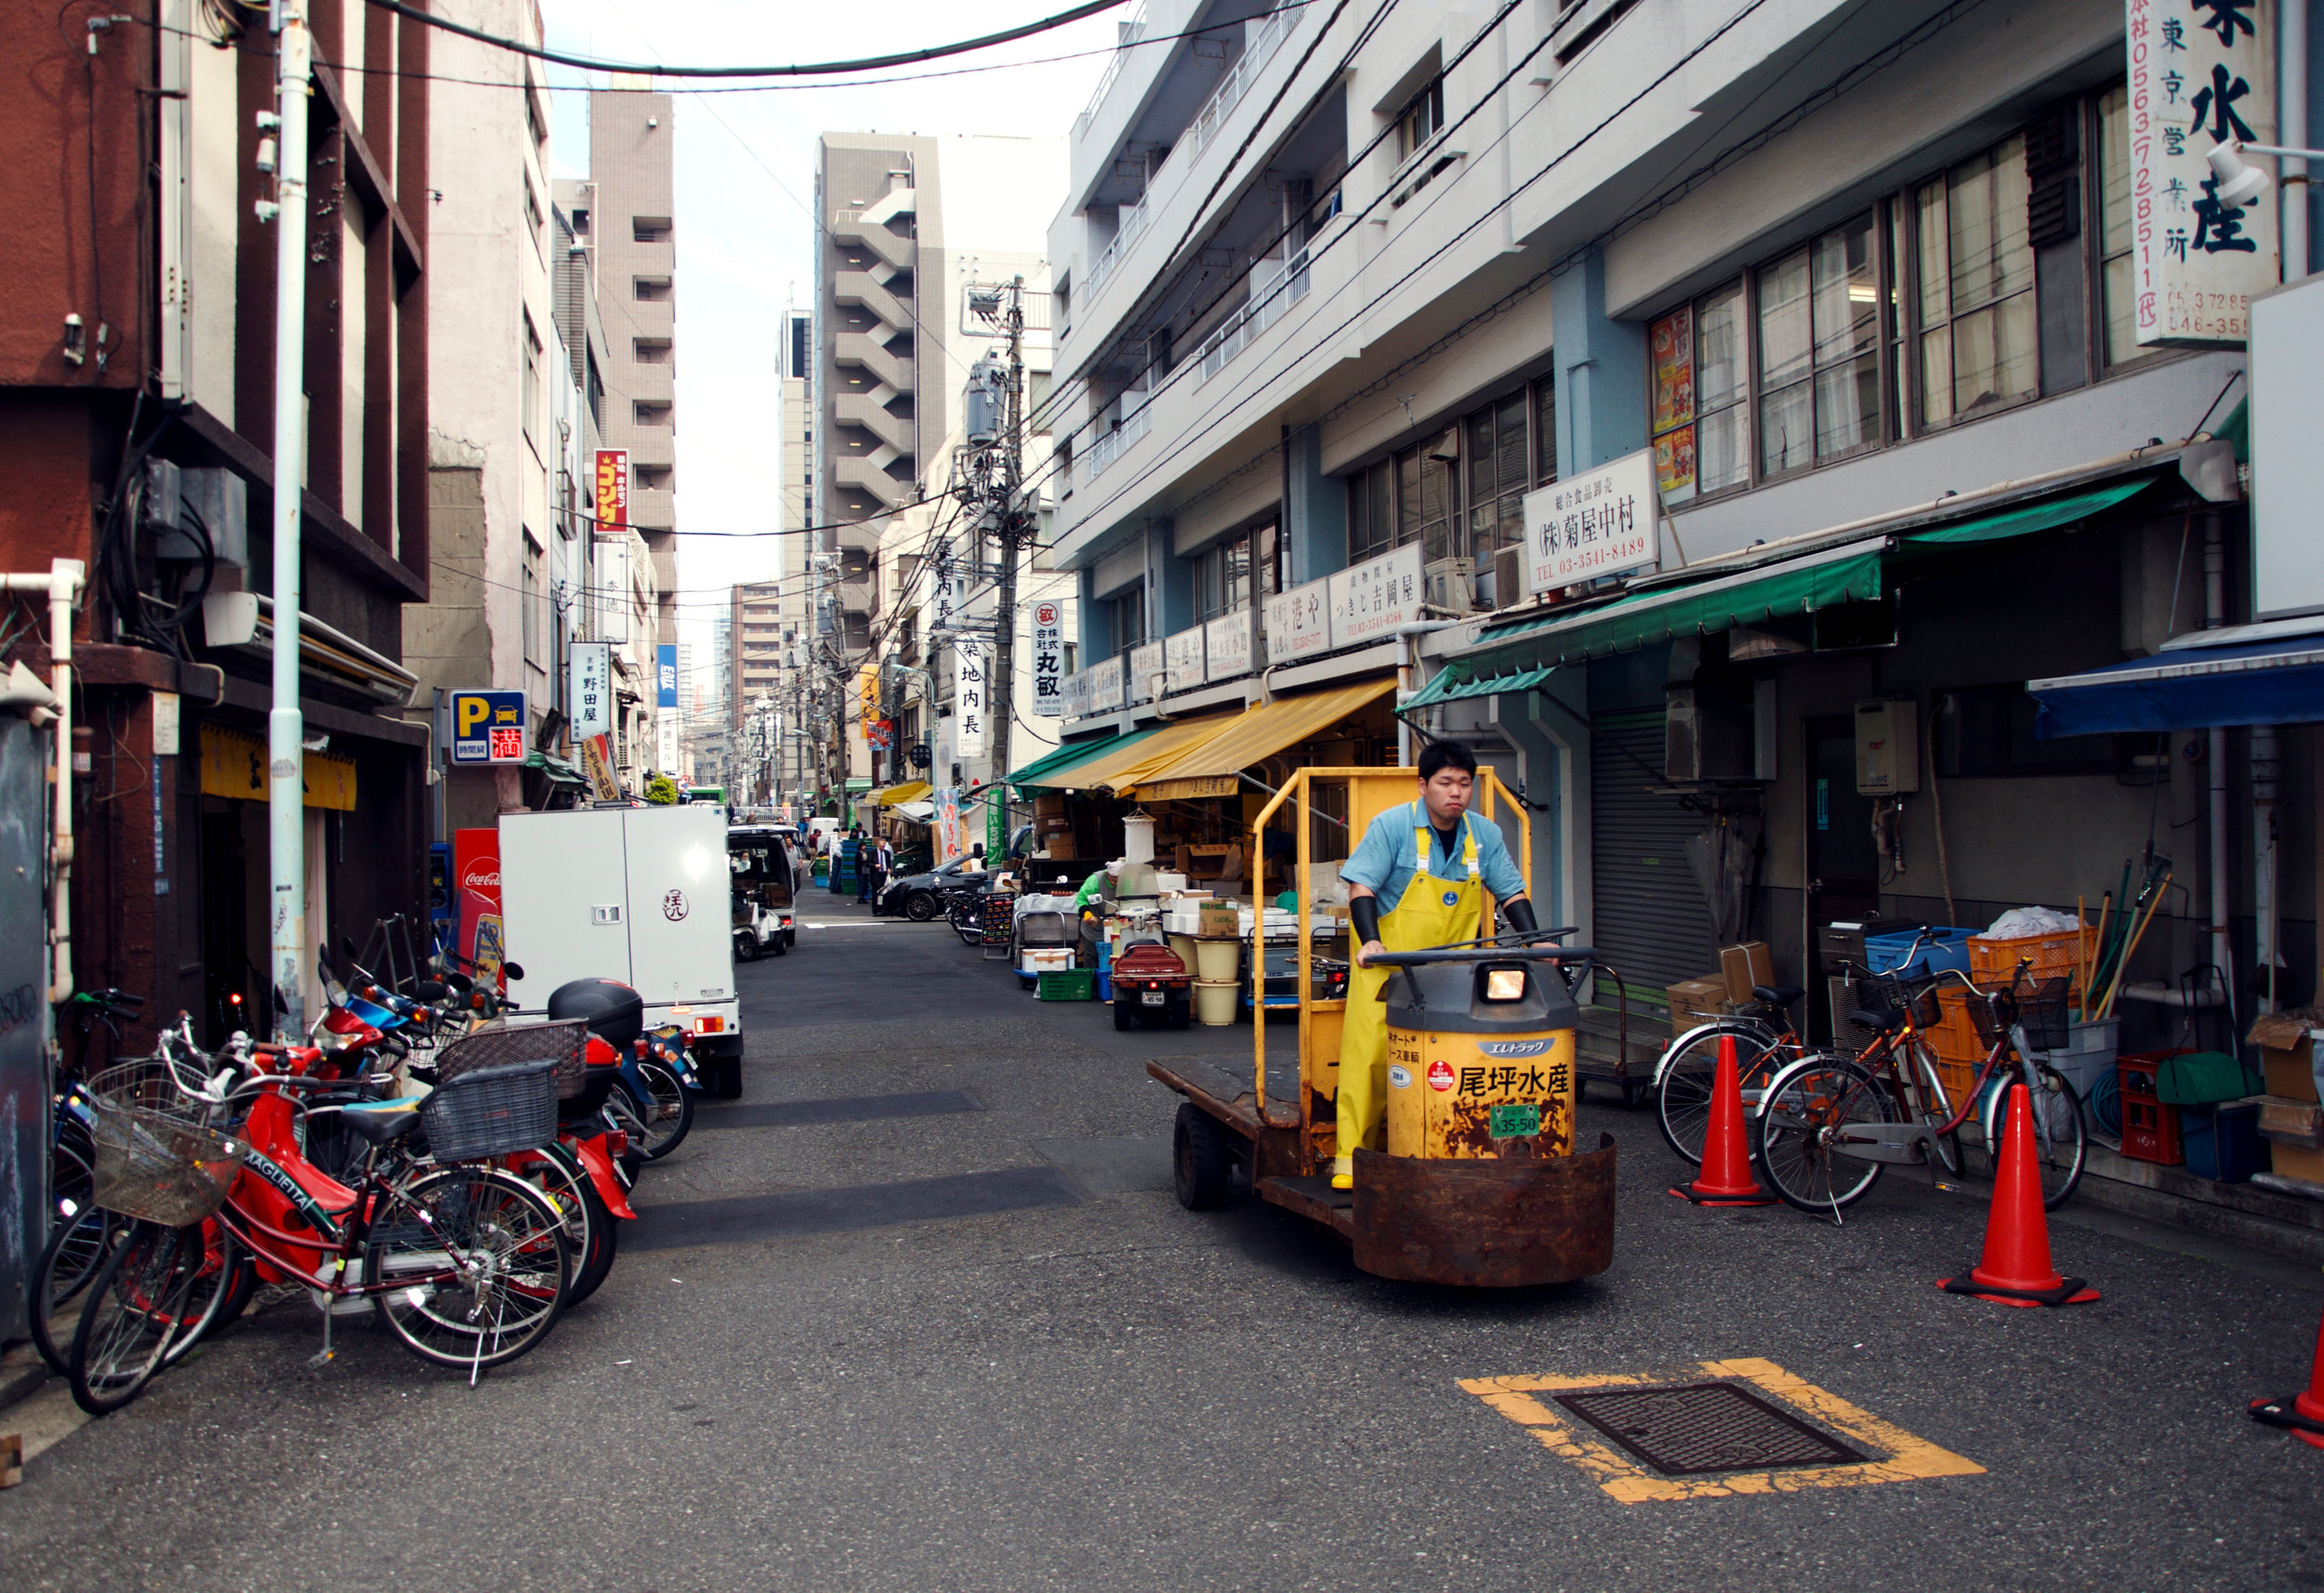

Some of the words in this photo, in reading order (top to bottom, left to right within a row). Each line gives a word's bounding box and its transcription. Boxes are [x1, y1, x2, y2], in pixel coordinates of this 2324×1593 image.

[2160, 17, 2189, 264] 東京営業所
[598, 464, 617, 528] ゴング
[1536, 564, 1554, 582] TEL
[1559, 536, 1644, 575] 03-3541-8489
[1038, 608, 1054, 623] 敏
[961, 638, 981, 734] 築地内長
[1036, 652, 1061, 697] 丸敏
[457, 697, 490, 737] P
[584, 678, 598, 721] 野田屋
[458, 744, 485, 756] 時間貸
[491, 729, 522, 758] 満
[1489, 1042, 1545, 1054] エレトラック
[1457, 1062, 1569, 1097] 尾坪水産
[1501, 1117, 1537, 1133] 35-50
